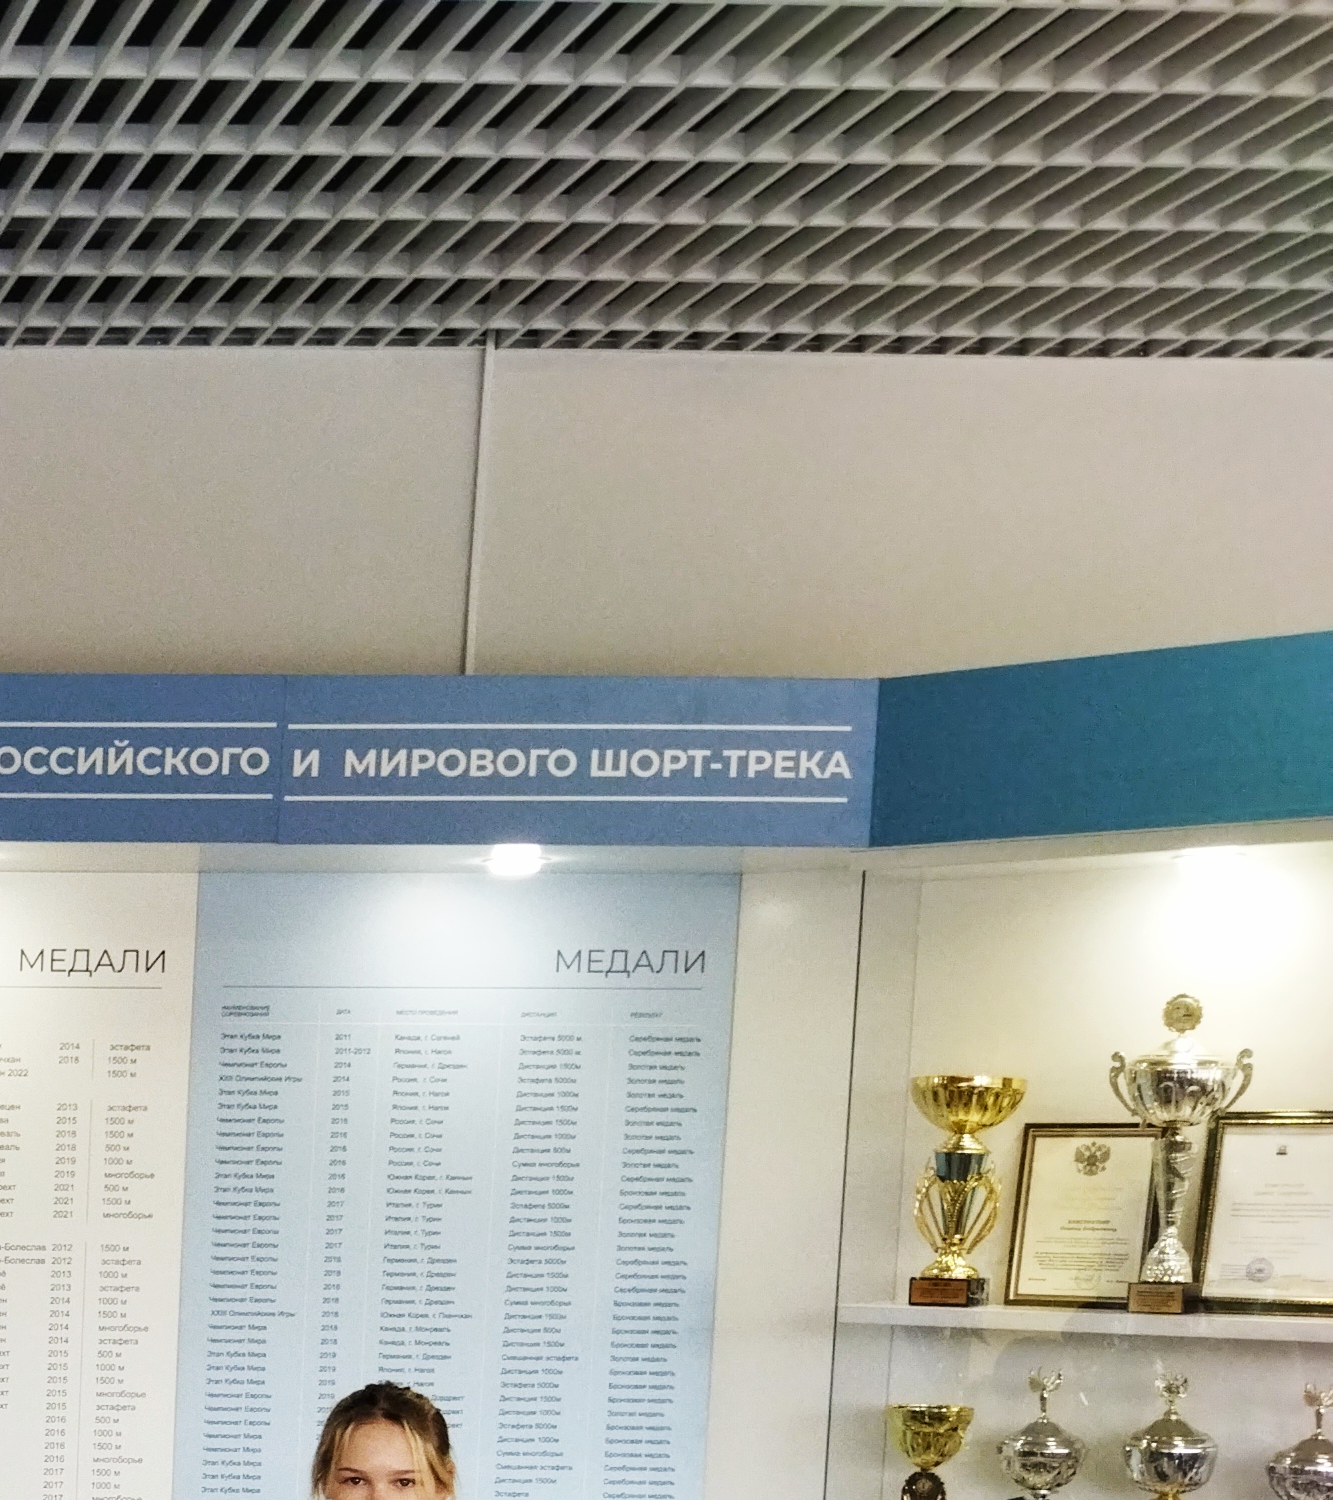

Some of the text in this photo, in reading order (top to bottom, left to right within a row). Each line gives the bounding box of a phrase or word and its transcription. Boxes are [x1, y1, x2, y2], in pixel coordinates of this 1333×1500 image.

[293, 748, 321, 778] И
[344, 746, 579, 780] МИРОВОГО
[590, 746, 852, 780] ШОРТ-ТРЕКА
[19, 948, 166, 977] МЕДАЛИ
[556, 949, 706, 978] МЕДАЛИ
[59, 1042, 80, 1051] 2014
[109, 1043, 151, 1053] эстафета
[107, 1056, 127, 1065] 1500
[8, 1068, 28, 1078] 2022
[57, 1102, 78, 1112] 2013
[56, 1116, 77, 1126] 2015
[45, 1454, 66, 1464] 2016
[92, 1455, 143, 1466] многоборье
